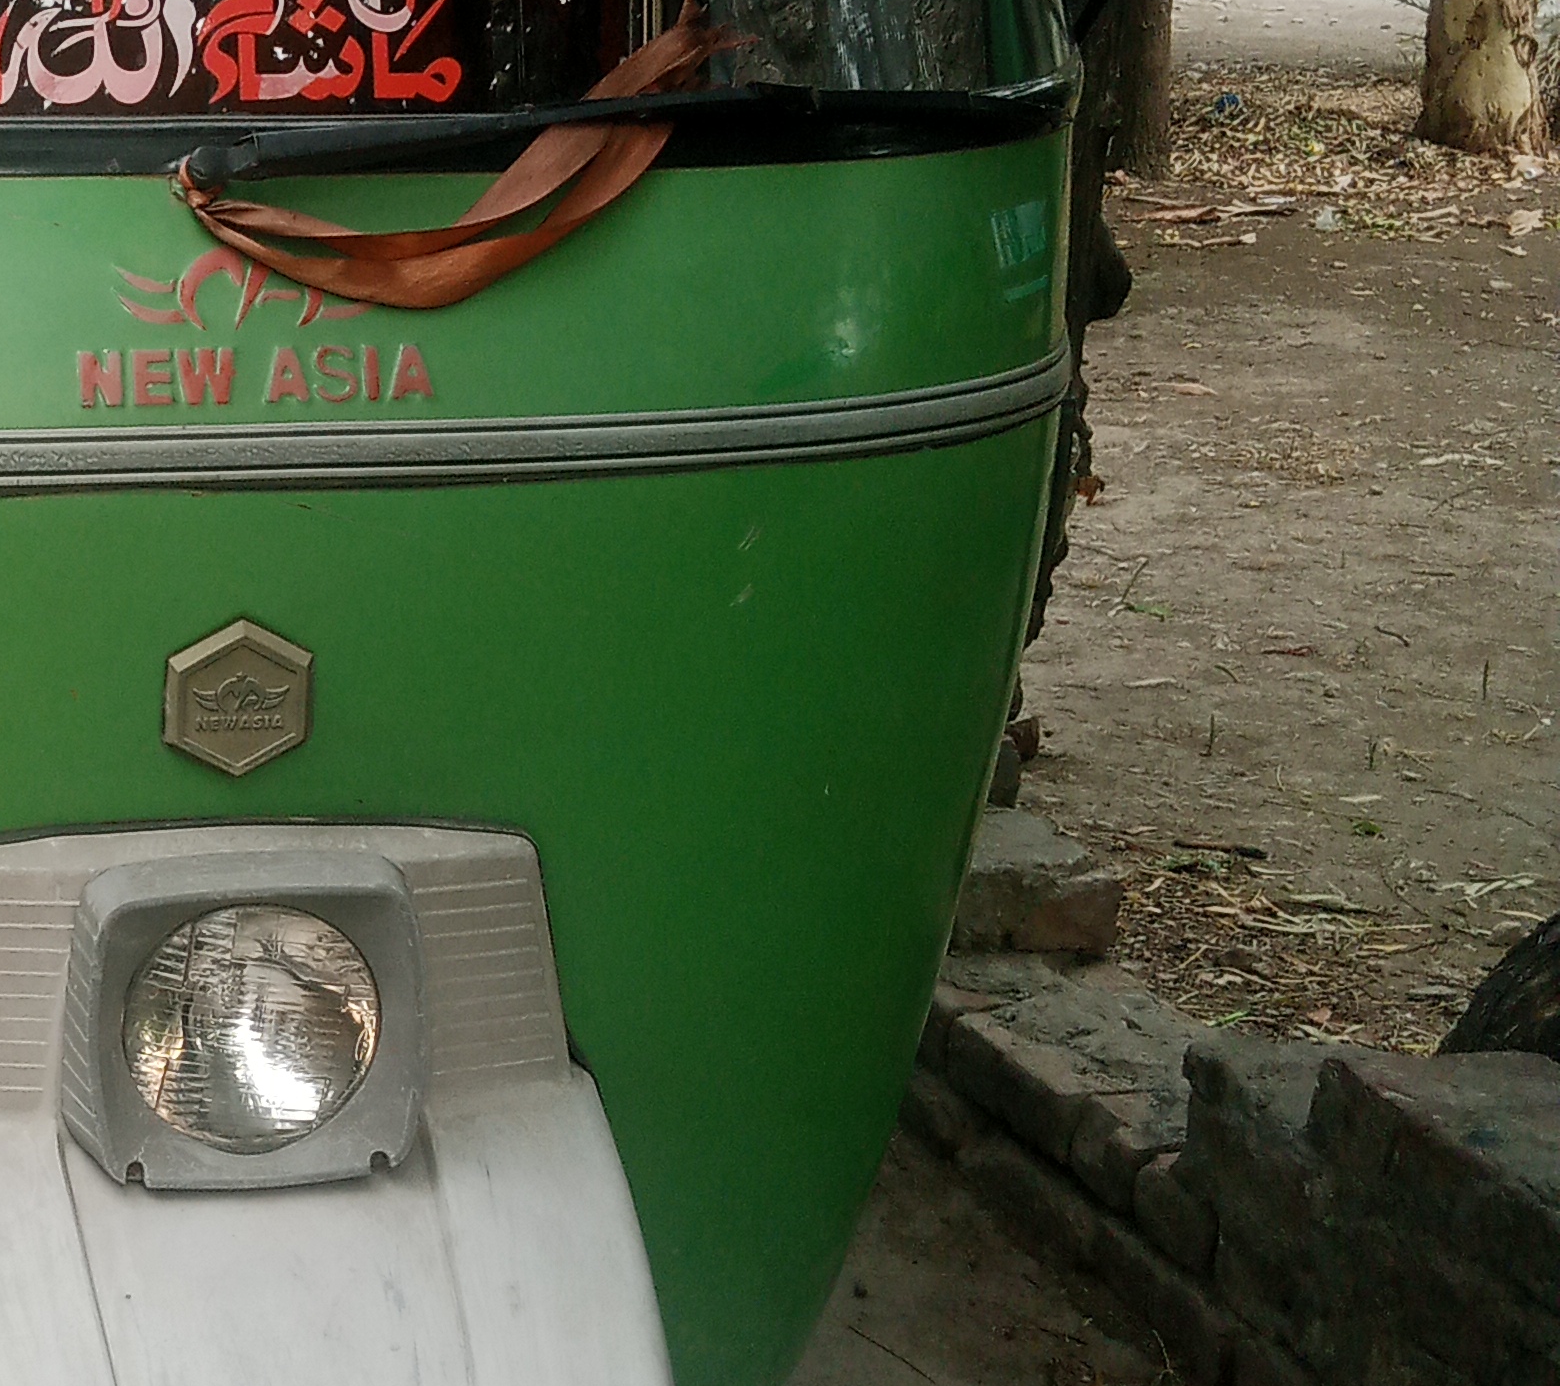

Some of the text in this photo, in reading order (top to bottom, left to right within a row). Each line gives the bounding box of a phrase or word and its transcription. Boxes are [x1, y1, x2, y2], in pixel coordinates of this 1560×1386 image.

[77, 344, 435, 409] NEW ASIA
[195, 715, 285, 732] NEW ASIA
